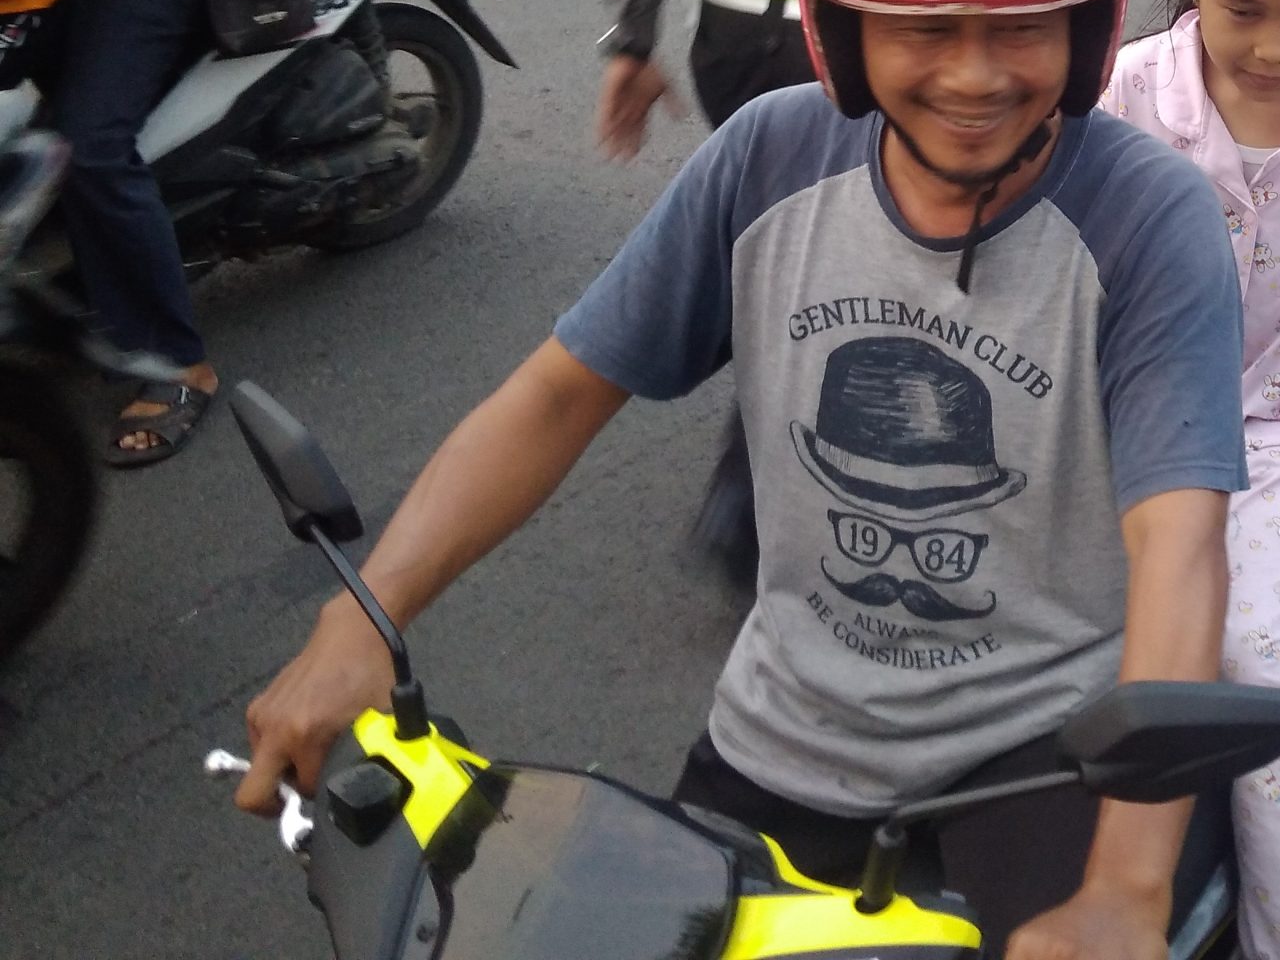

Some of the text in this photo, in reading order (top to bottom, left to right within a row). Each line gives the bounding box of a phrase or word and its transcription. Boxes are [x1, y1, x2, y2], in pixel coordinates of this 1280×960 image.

[788, 297, 1054, 400] GENTLEMAN CLUB
[850, 521, 967, 574] 19 84
[805, 591, 1003, 672] BE CONSIDERATE
